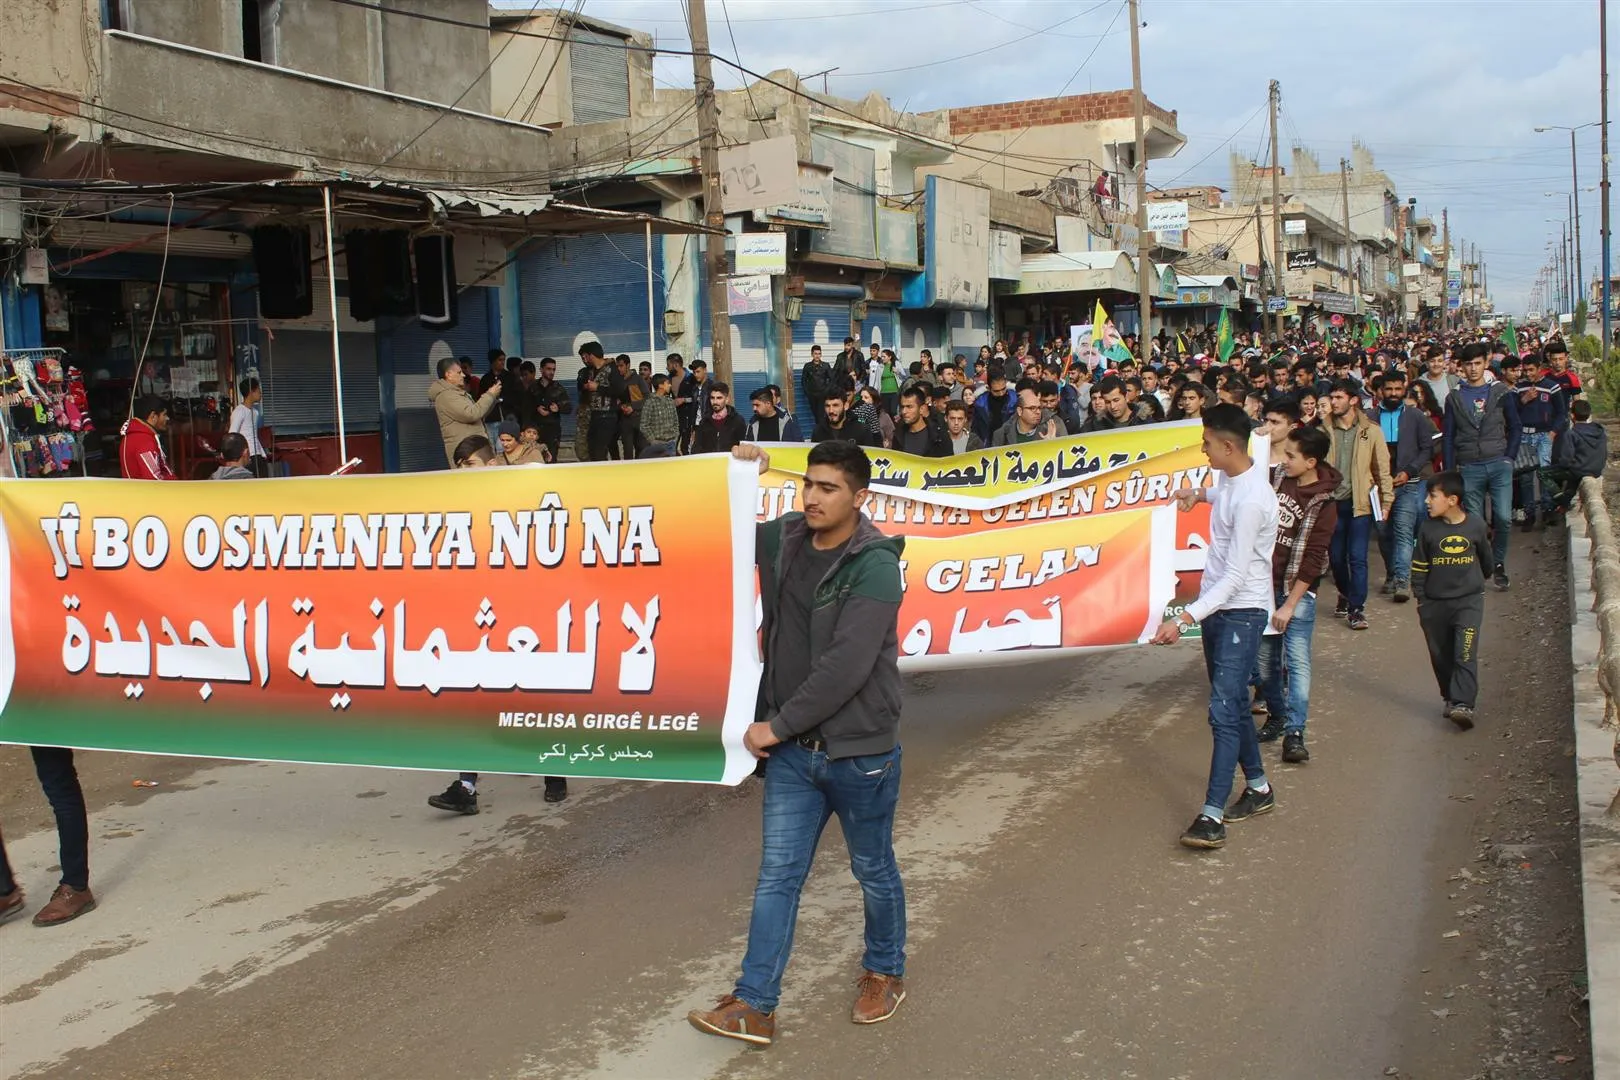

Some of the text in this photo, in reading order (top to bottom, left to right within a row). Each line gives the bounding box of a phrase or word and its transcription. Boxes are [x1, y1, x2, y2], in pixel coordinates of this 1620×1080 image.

[920, 455, 1000, 492] العصر
[1005, 445, 1102, 484] مقاومة
[1103, 468, 1220, 510] SÛRIY
[91, 514, 170, 571] BO
[182, 512, 477, 571] OSMANIYA
[488, 491, 570, 570] NÛ
[580, 504, 662, 569] NA
[1432, 555, 1474, 566] BATMAN
[61, 593, 661, 710] لا للعثمانية الجديدة
[498, 710, 700, 731] MECLISA GIRGÊ LEGÊ
[609, 744, 654, 763] مجلس
